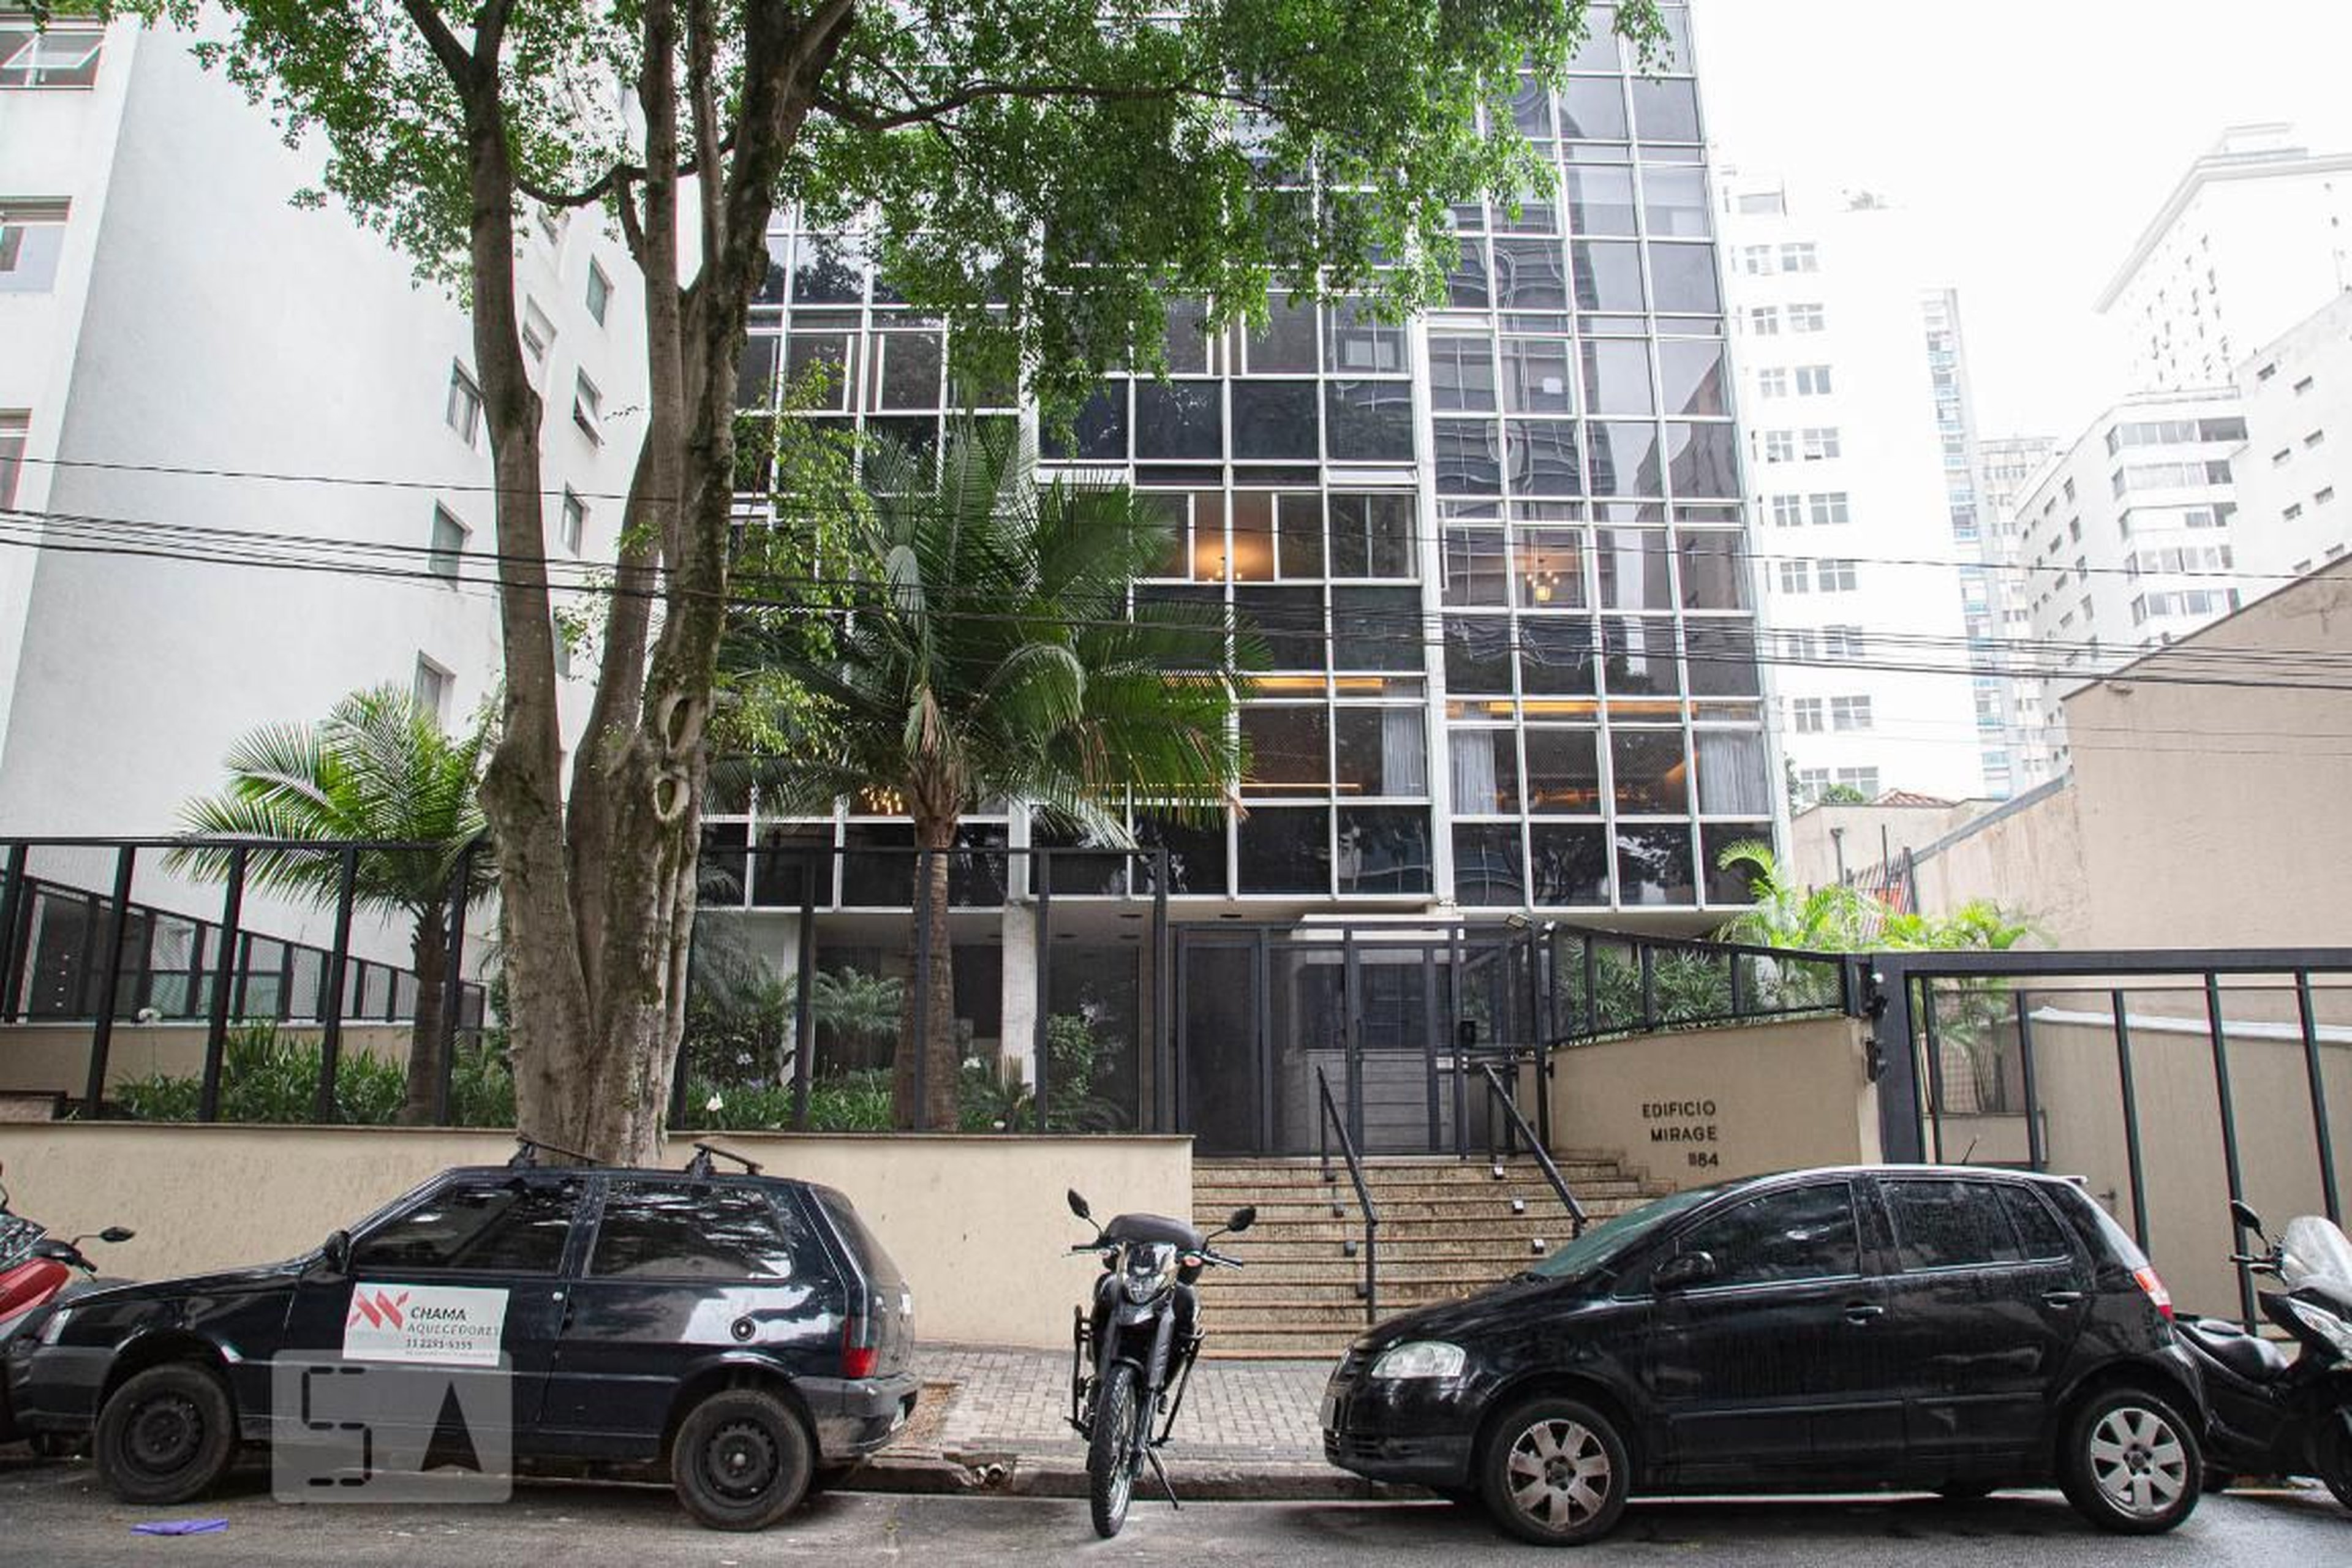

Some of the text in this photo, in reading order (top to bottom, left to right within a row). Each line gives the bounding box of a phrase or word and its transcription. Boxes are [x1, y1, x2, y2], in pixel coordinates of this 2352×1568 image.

[1642, 1101, 1716, 1118] EDIFICIO
[1651, 1126, 1717, 1142] MIRAGE
[411, 1306, 467, 1321] CHAMA
